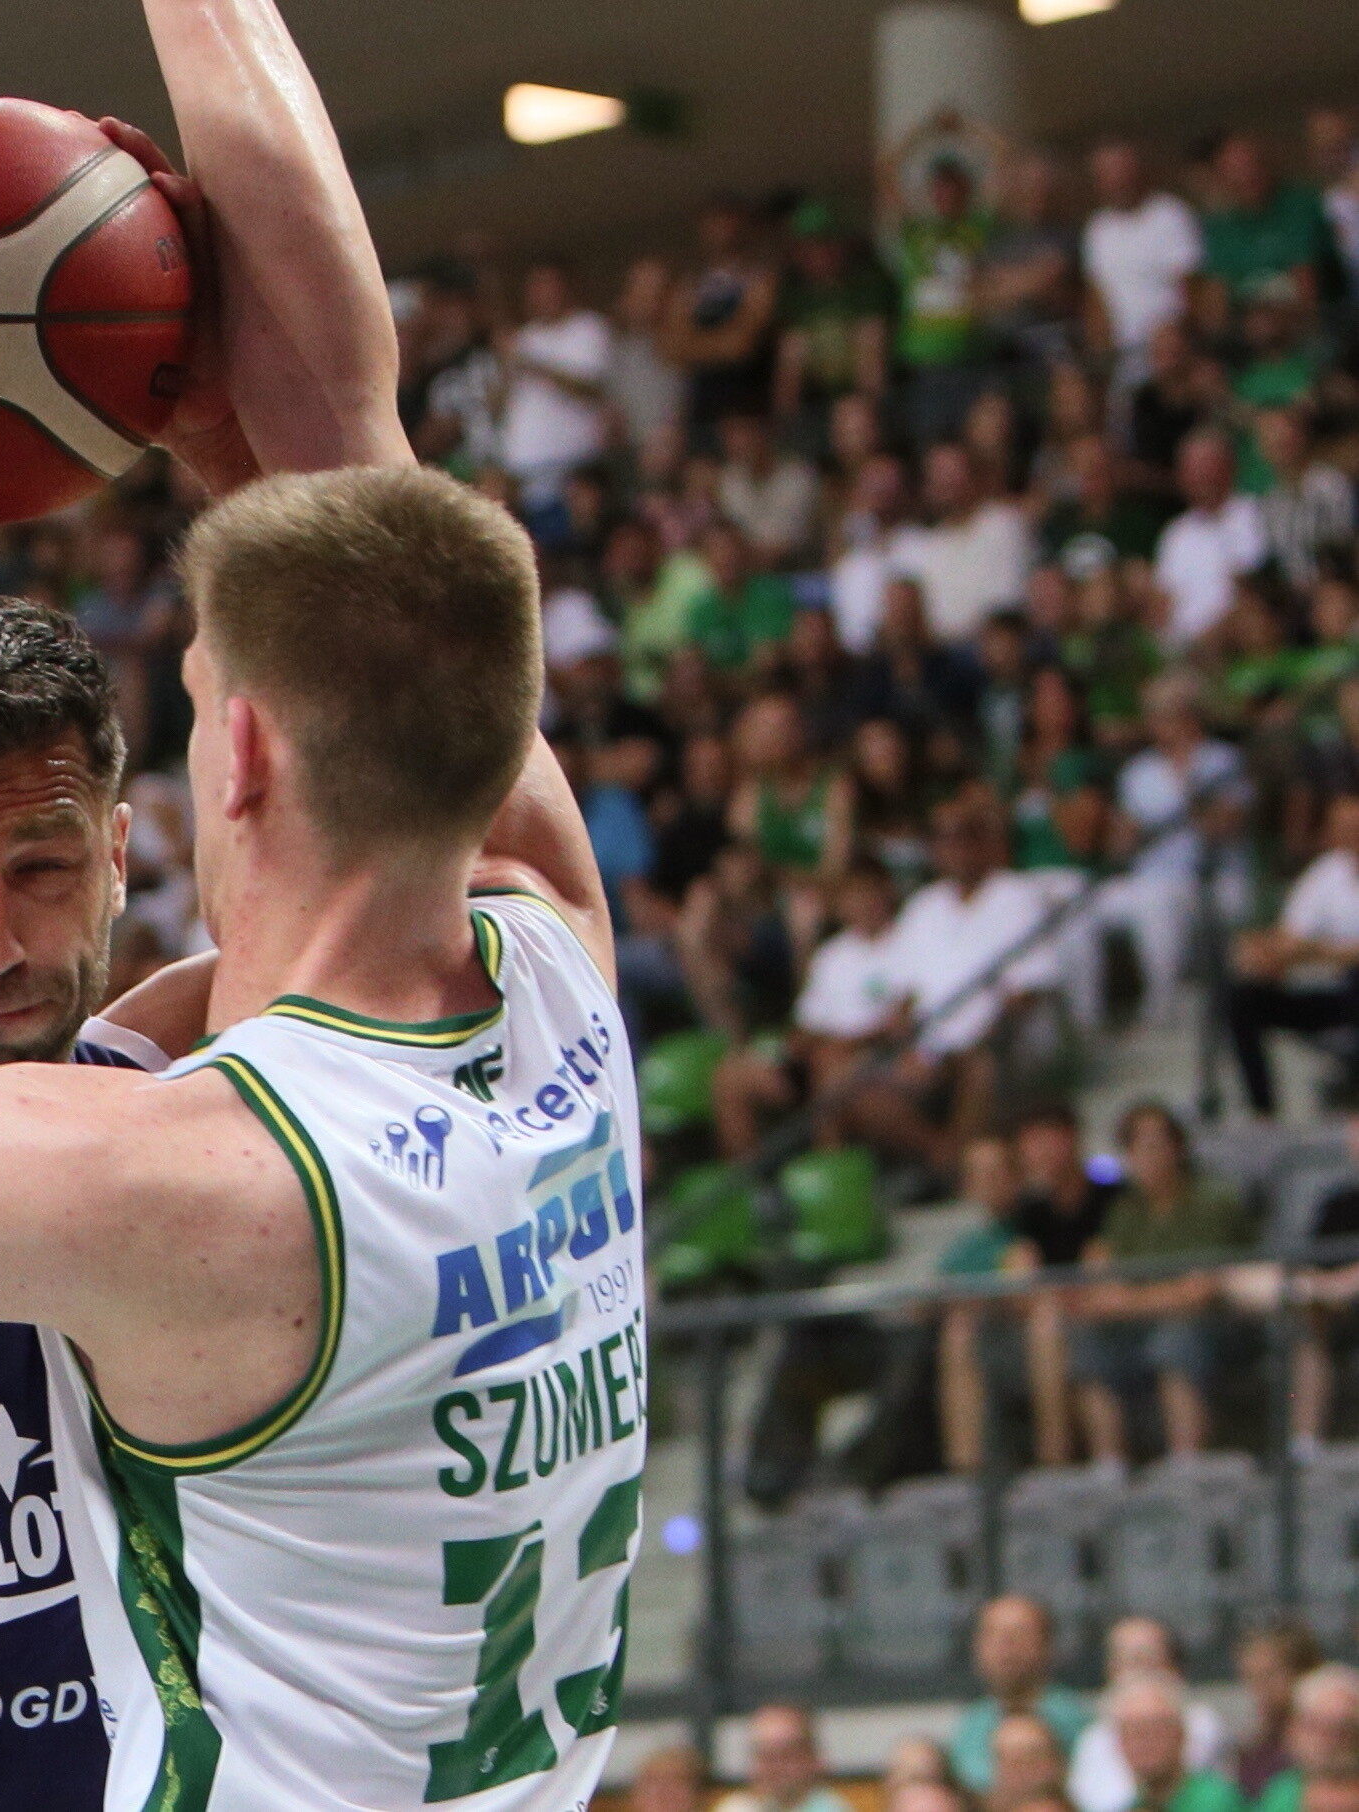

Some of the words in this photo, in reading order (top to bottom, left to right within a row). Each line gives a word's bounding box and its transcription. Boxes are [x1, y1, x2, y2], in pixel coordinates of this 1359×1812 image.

[432, 1306, 646, 1498] SZUMER
[10, 1674, 96, 1729] GD
[423, 1476, 641, 1804] 13
